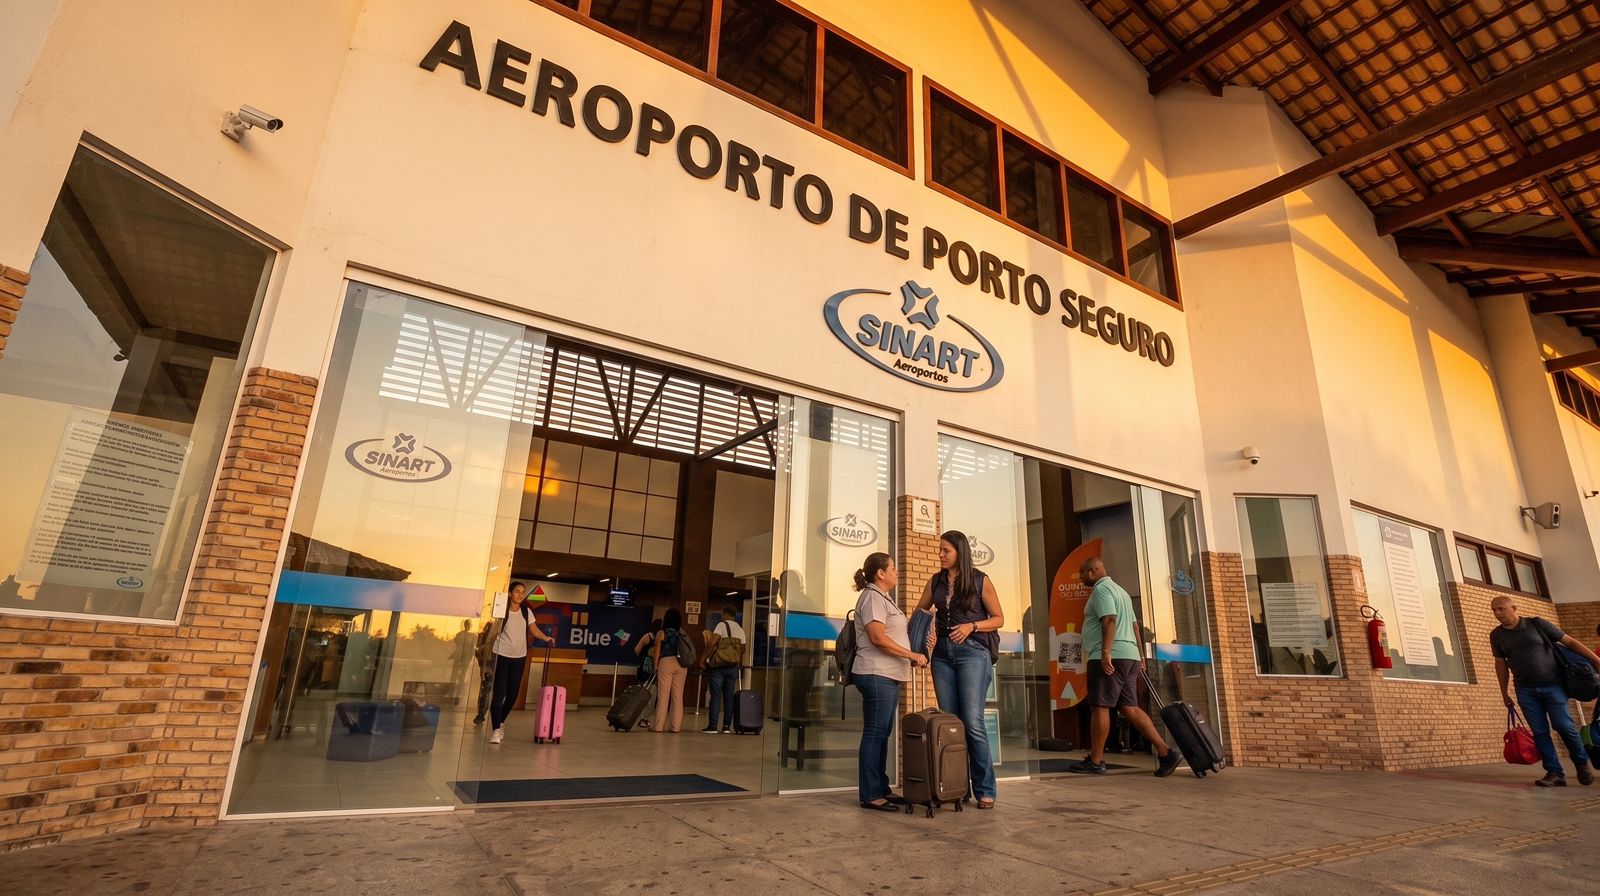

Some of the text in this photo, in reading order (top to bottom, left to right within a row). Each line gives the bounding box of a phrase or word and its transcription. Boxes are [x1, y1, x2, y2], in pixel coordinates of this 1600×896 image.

[419, 20, 1175, 368] AEROPORTO DE PORTO SEGURO
[856, 313, 980, 378] SINART
[893, 358, 949, 384] Aeroportos
[365, 452, 436, 473] SINART
[832, 526, 869, 540] SINART
[570, 628, 611, 646] Blue
